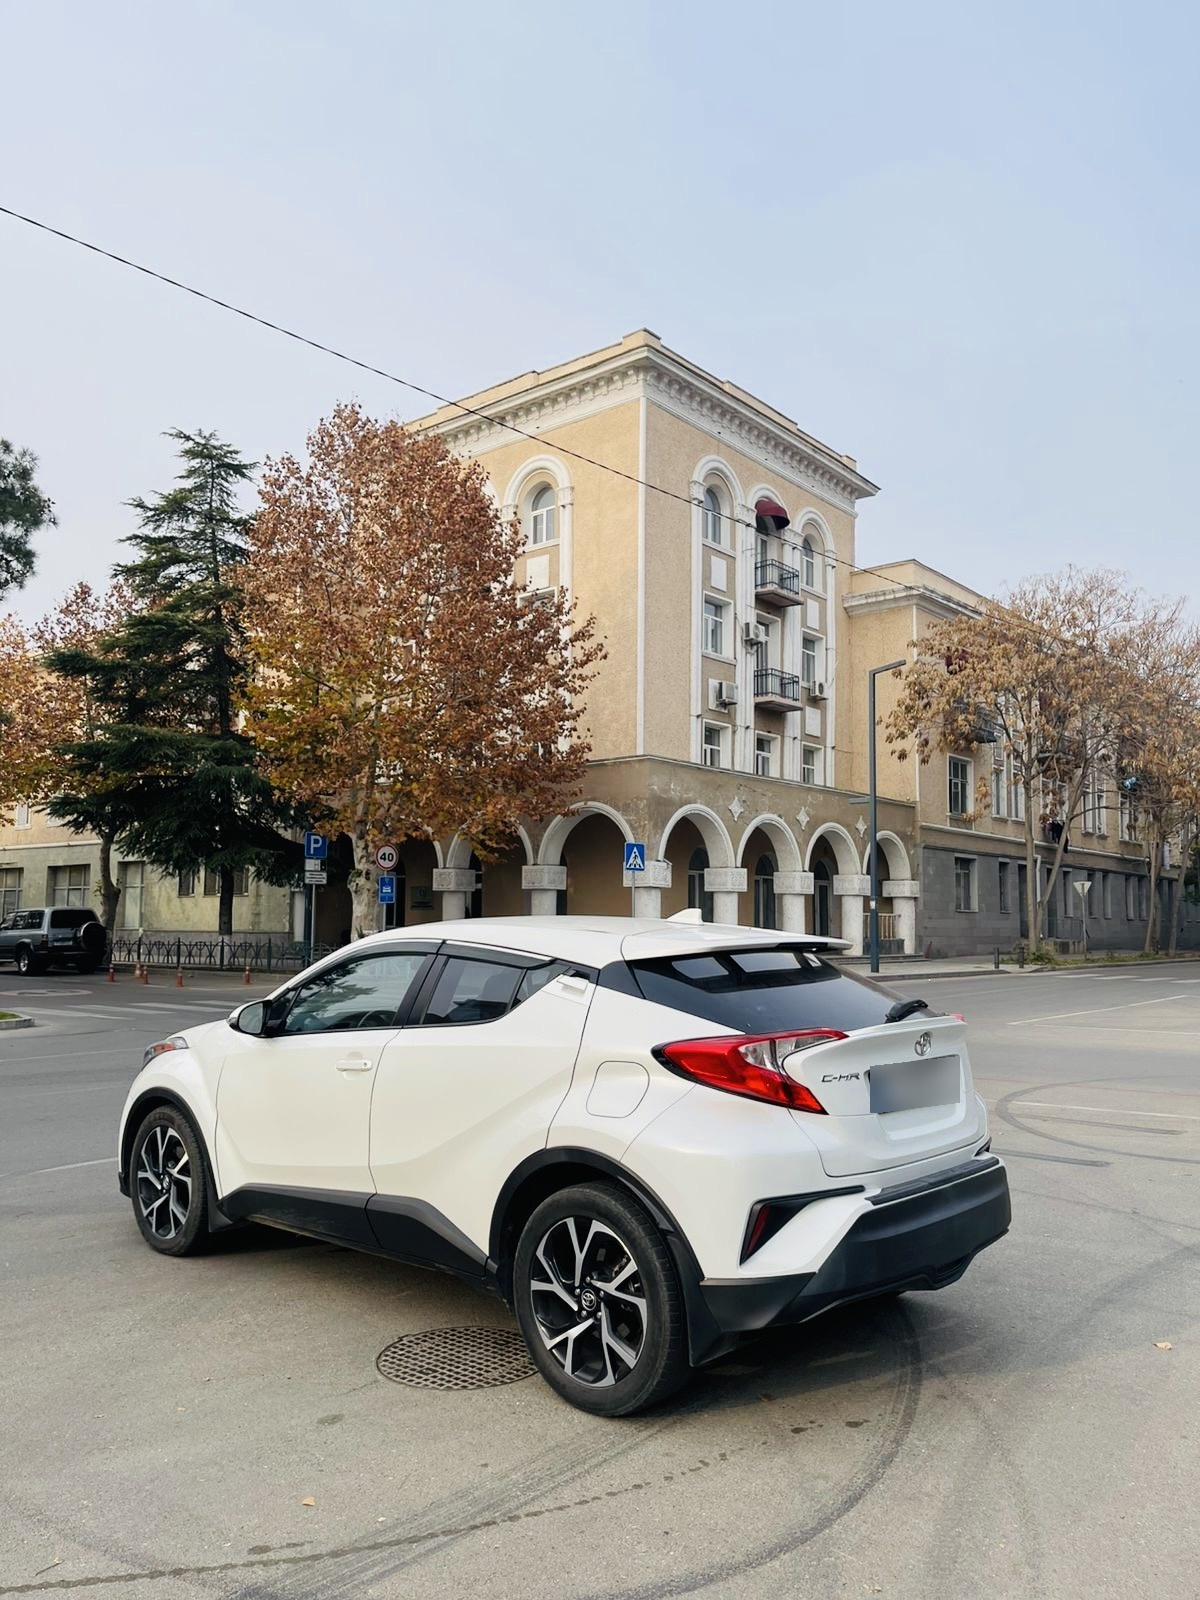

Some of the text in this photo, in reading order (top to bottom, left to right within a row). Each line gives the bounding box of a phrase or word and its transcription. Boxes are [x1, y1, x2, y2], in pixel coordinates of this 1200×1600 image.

[310, 835, 322, 854] P
[380, 852, 394, 862] 40
[821, 1072, 860, 1083] C-HR
